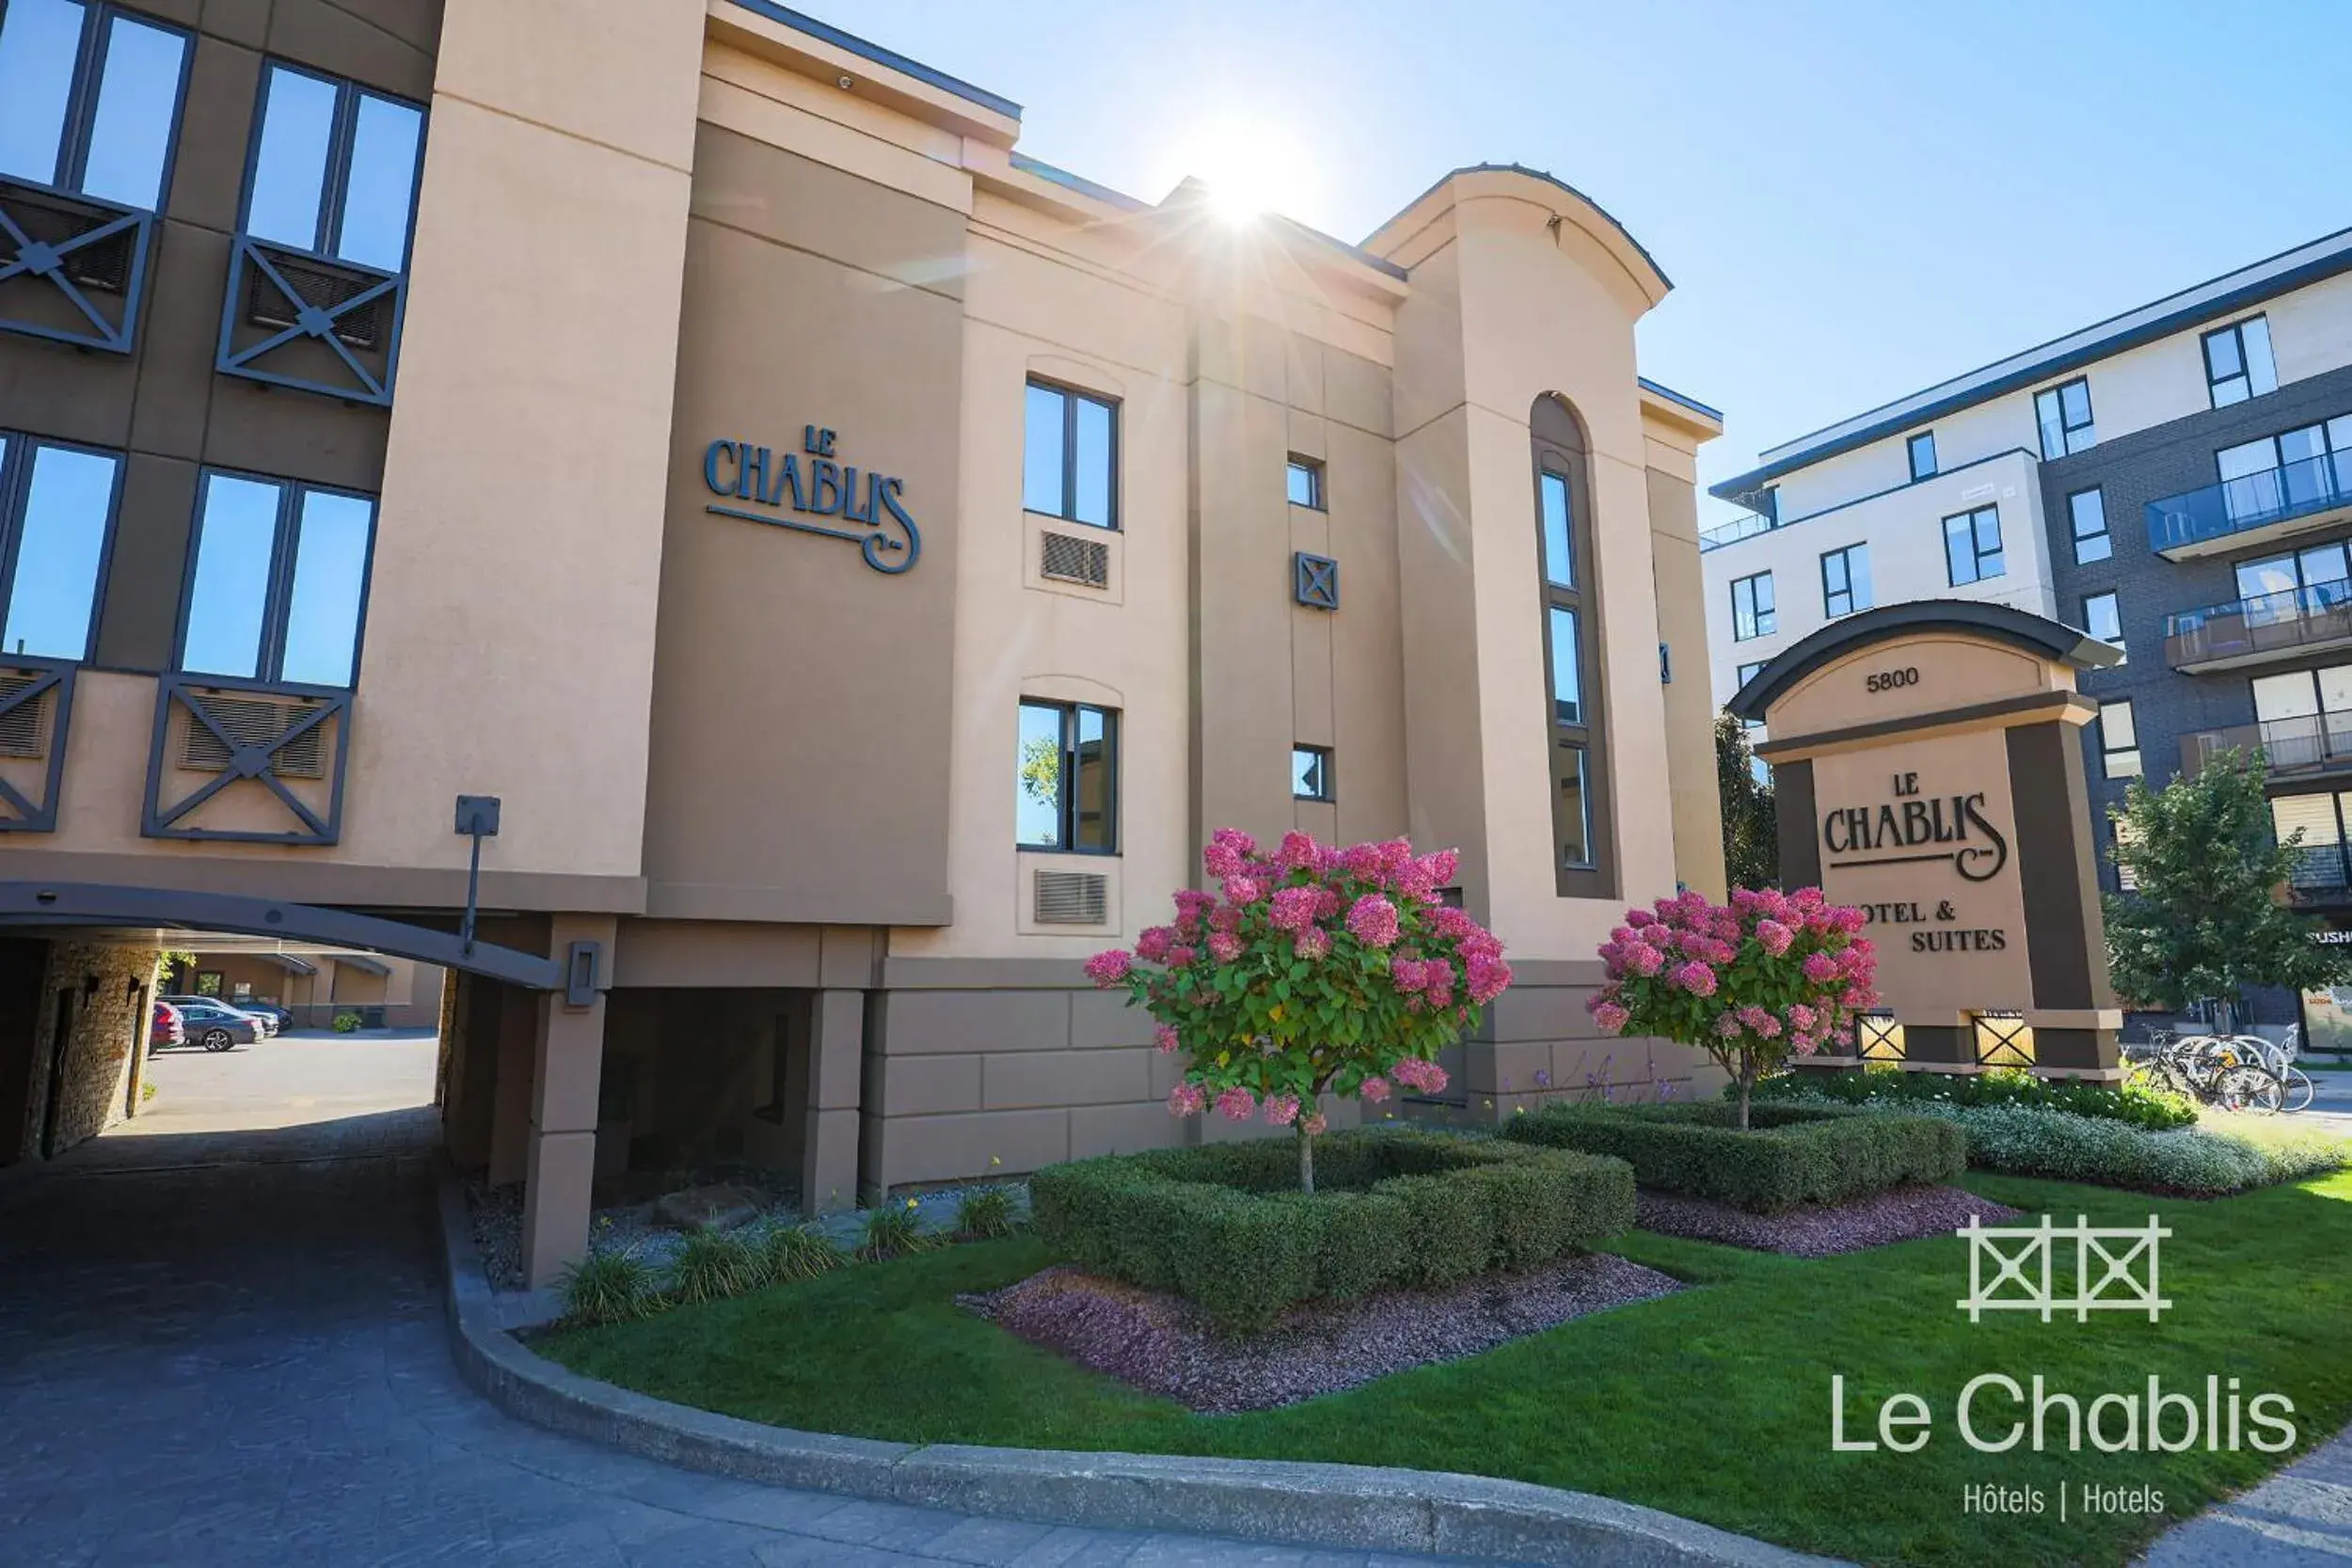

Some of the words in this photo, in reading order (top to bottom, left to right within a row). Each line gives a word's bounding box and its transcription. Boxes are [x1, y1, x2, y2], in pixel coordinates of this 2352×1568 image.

[804, 424, 836, 457] LE
[704, 439, 921, 575] CHABLIS
[1867, 667, 1919, 693] 5800
[1894, 772, 1919, 797] LE
[1824, 792, 2008, 882] CHABLIS
[1838, 902, 1927, 925] OTEL
[1935, 899, 1956, 921] &
[1912, 928, 2007, 953] SUITES
